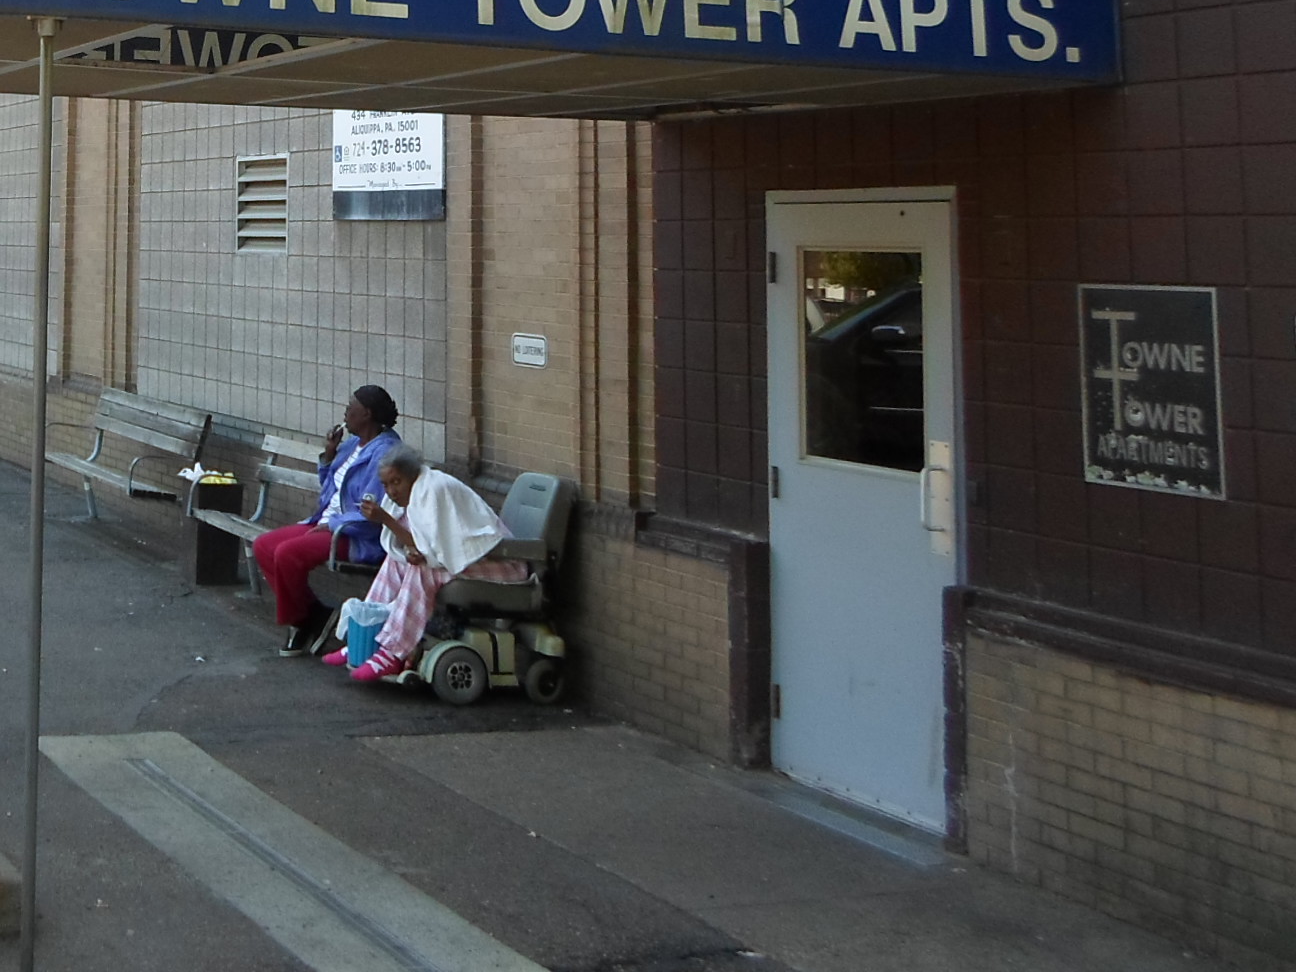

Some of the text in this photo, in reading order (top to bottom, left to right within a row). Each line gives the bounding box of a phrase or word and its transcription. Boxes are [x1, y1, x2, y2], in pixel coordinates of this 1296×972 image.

[397, 119, 419, 132] 15001
[352, 136, 421, 157] 724-378-8563
[339, 164, 357, 175] OFFICE
